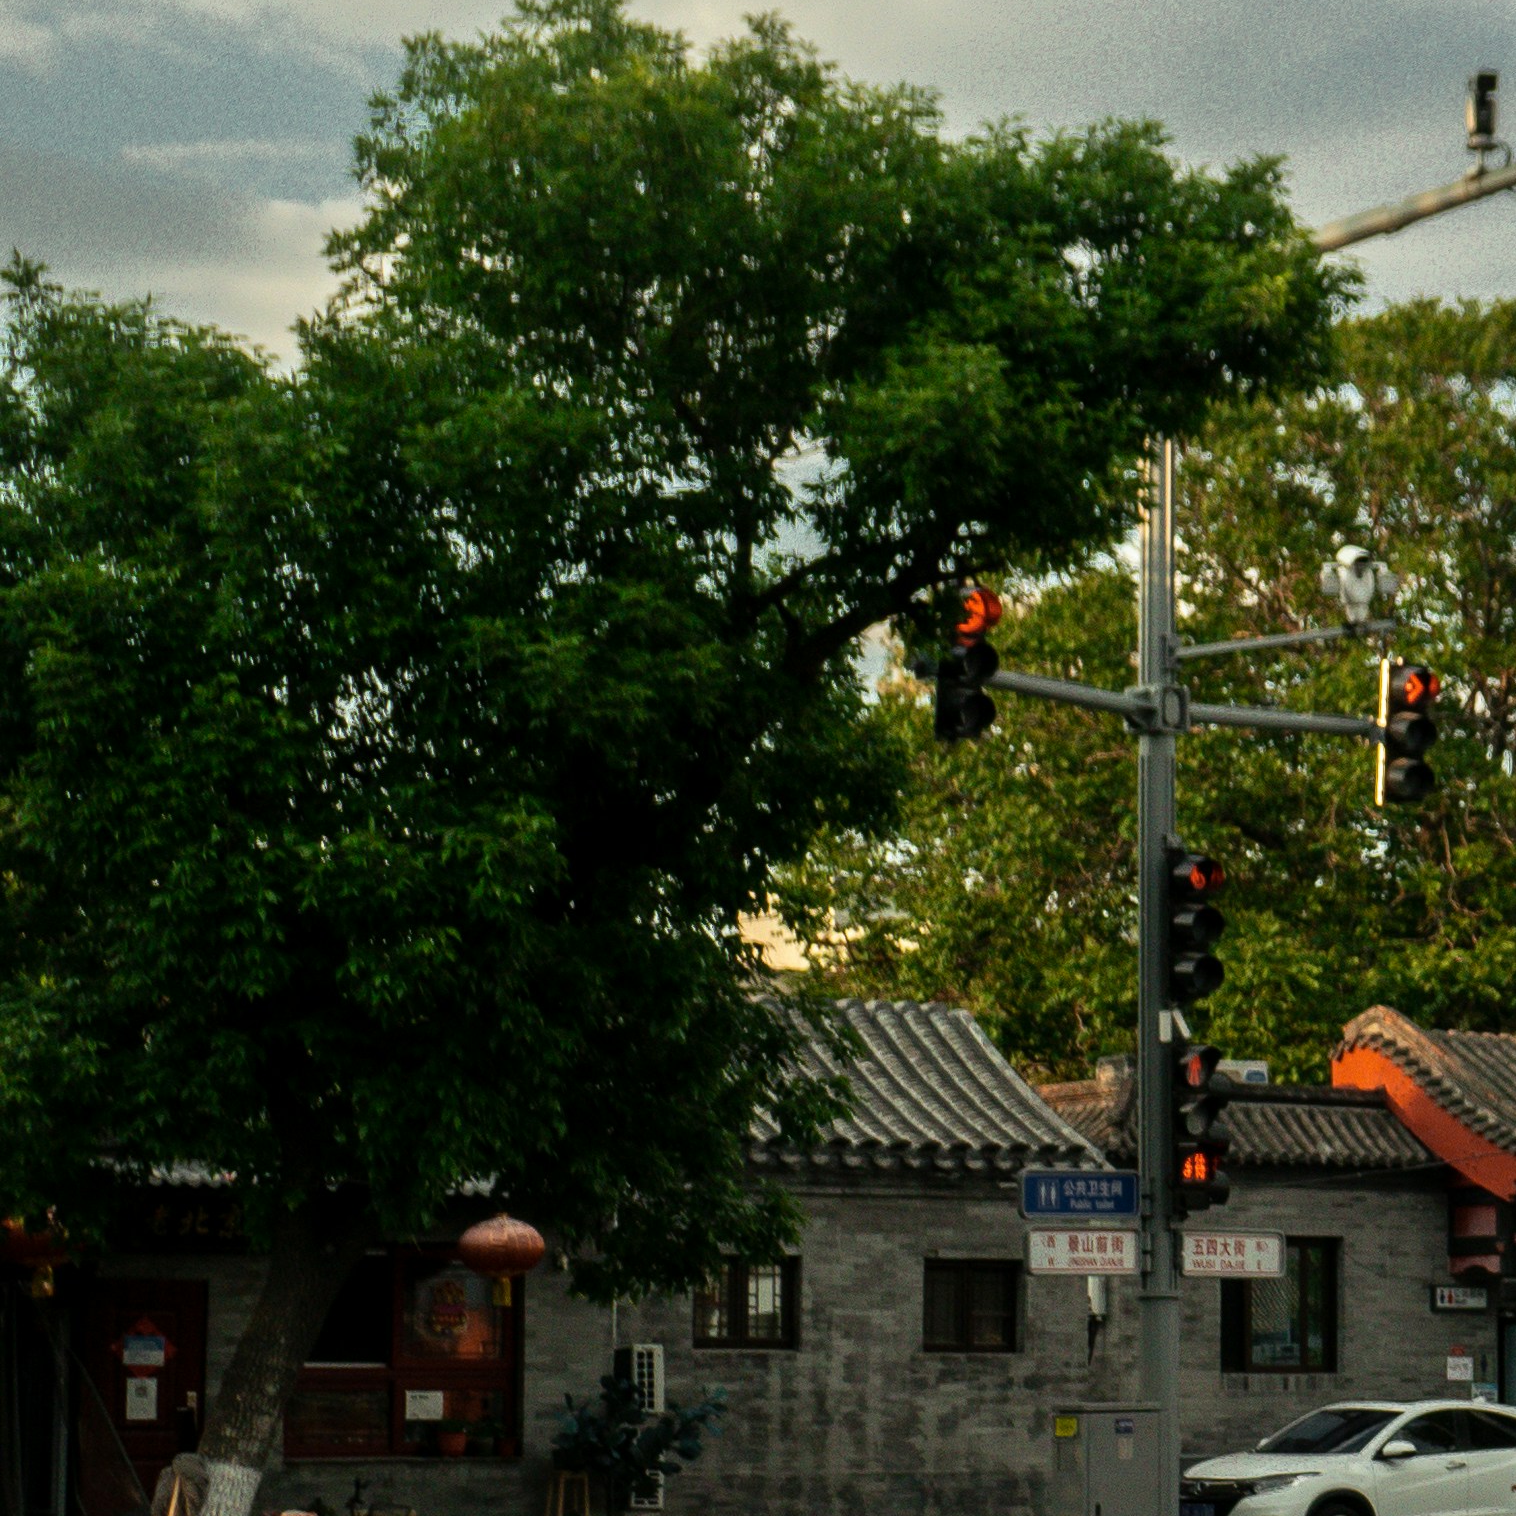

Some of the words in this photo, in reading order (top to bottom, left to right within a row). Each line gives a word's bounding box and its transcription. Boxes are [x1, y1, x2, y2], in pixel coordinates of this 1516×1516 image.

[1062, 1179, 1123, 1197] 公共卫生间
[1192, 1238, 1245, 1257] 五四大街
